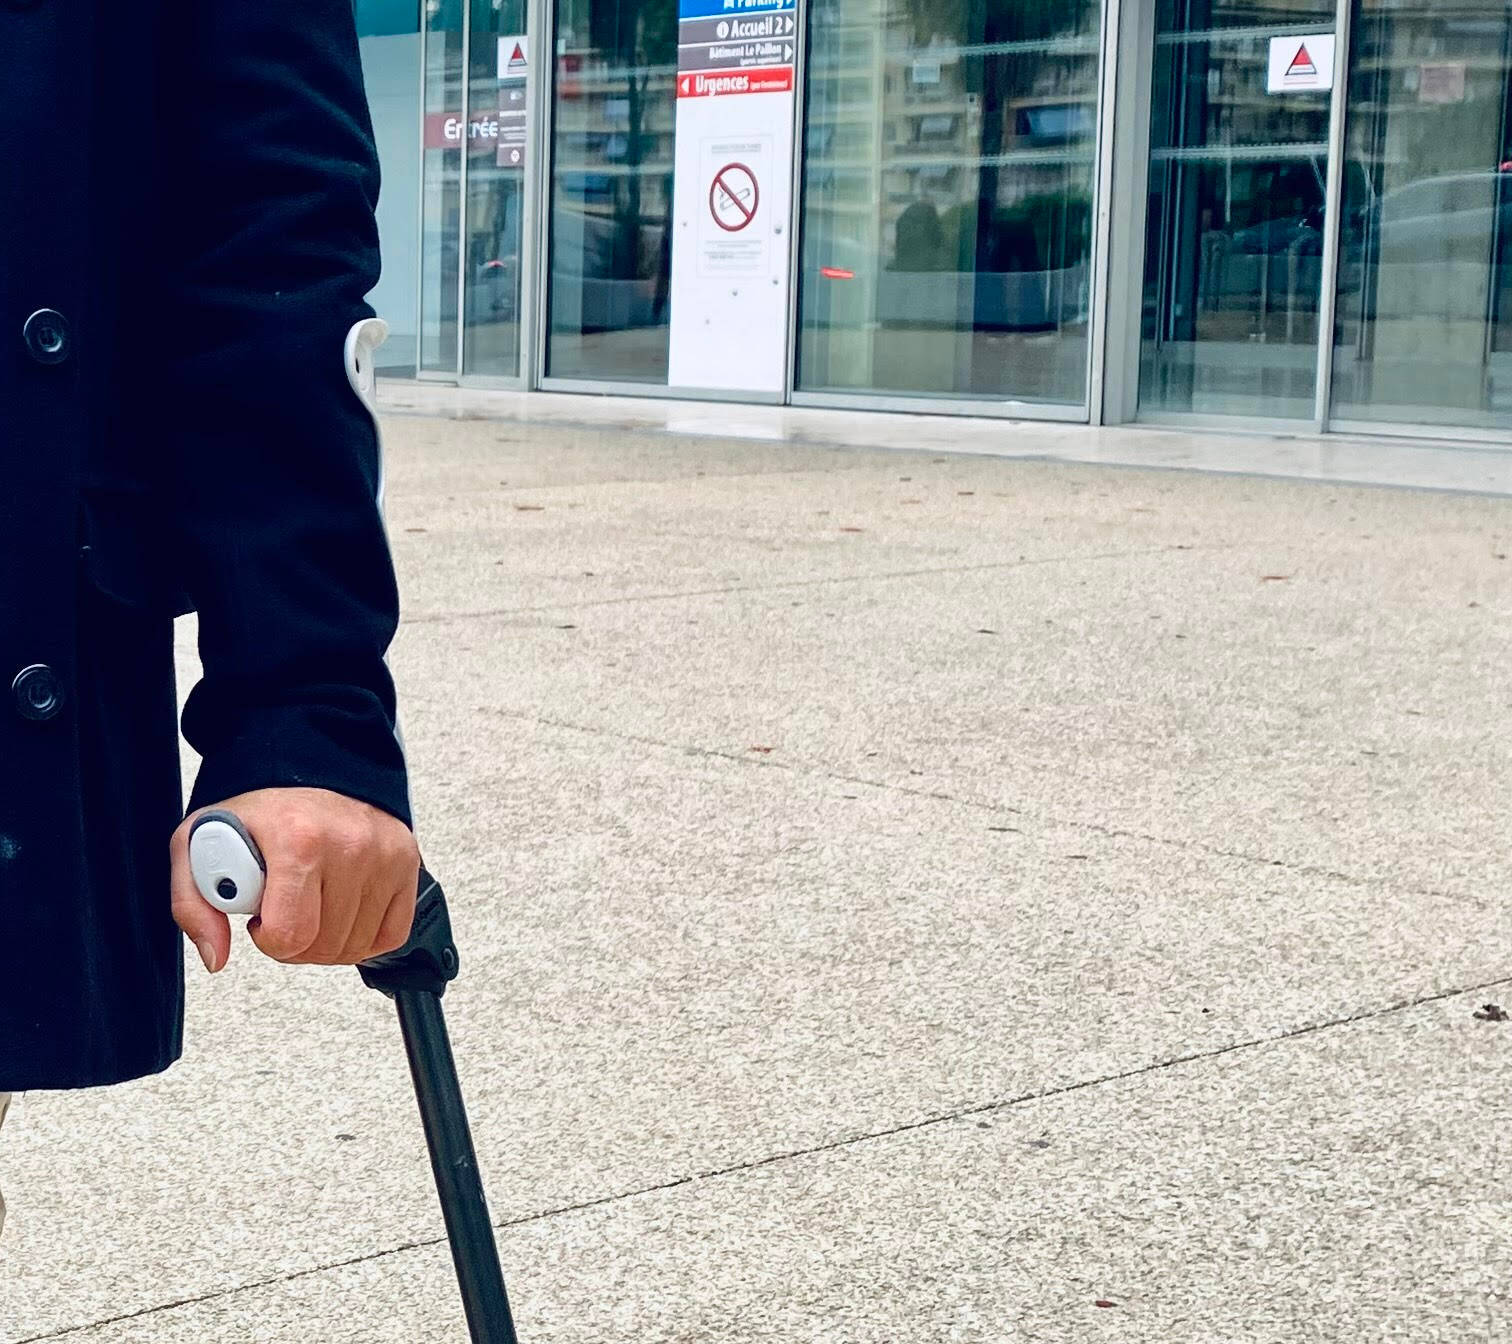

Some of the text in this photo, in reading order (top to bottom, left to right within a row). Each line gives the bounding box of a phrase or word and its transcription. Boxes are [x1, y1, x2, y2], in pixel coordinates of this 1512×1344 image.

[731, 17, 783, 38] Accueil 2
[695, 75, 749, 96] Urgences
